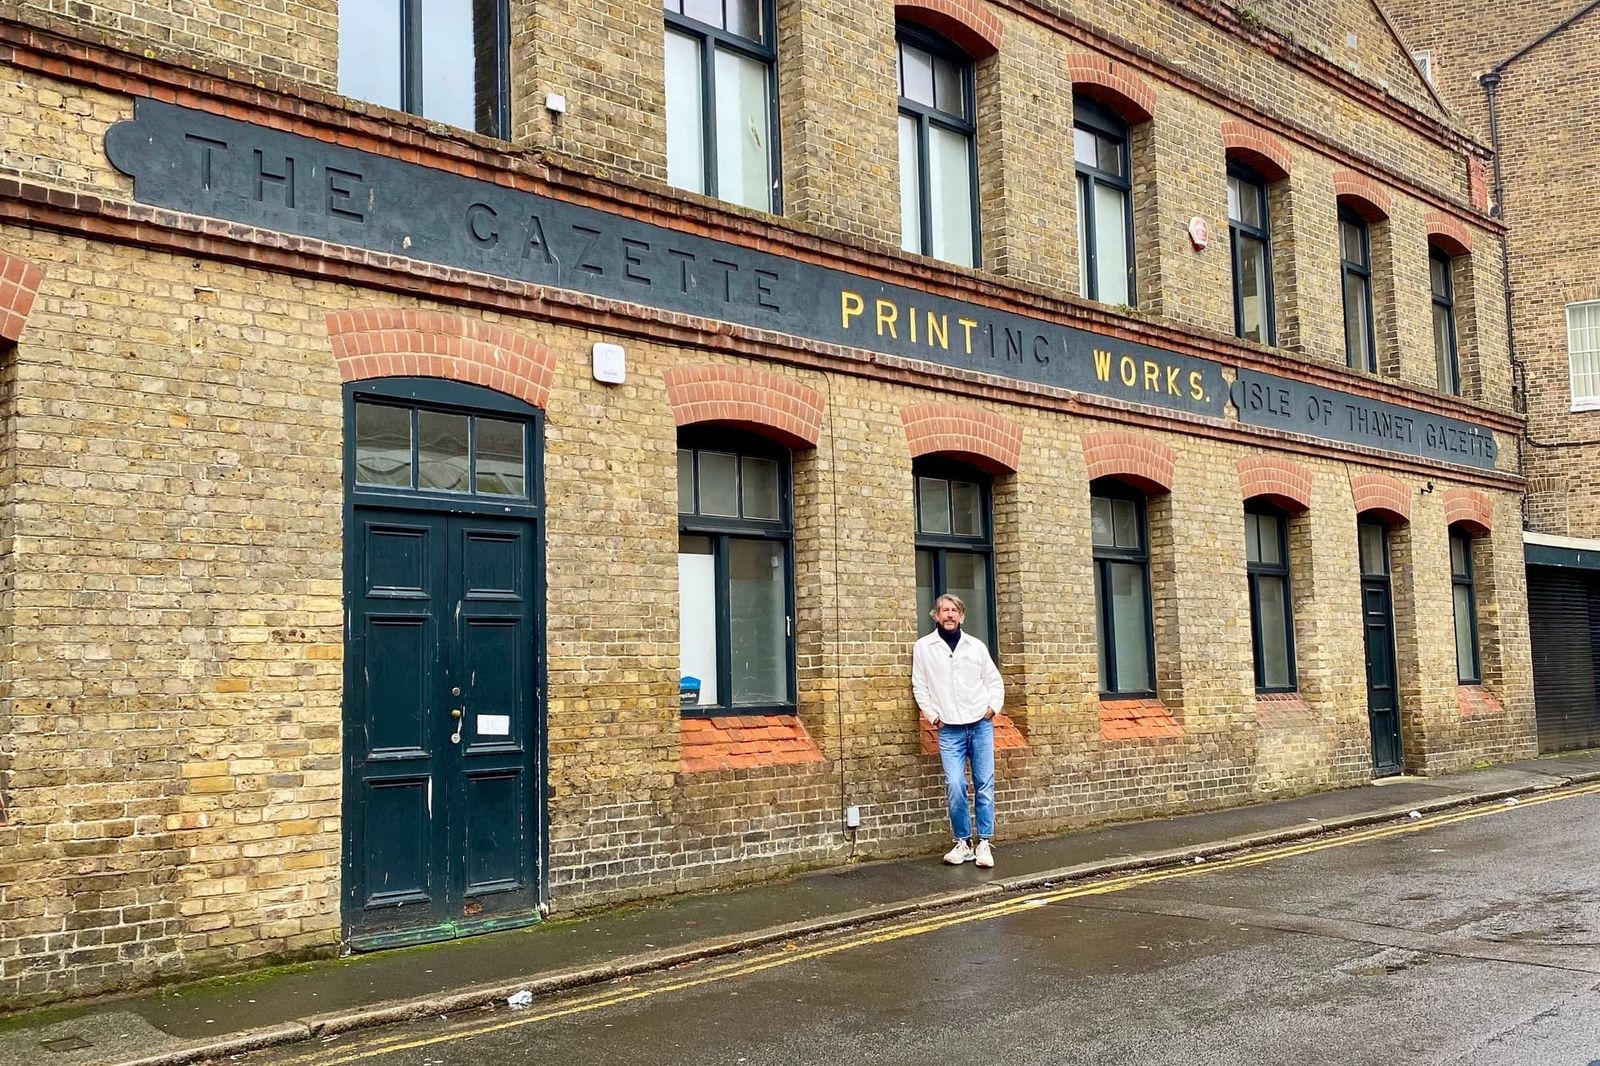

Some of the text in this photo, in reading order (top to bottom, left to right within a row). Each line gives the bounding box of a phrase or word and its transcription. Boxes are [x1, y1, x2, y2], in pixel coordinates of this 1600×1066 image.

[185, 132, 1211, 402] THE GAZETTE PRINTING WORKS.
[1241, 380, 1494, 460] ISLE OF THANET GAZETTE
